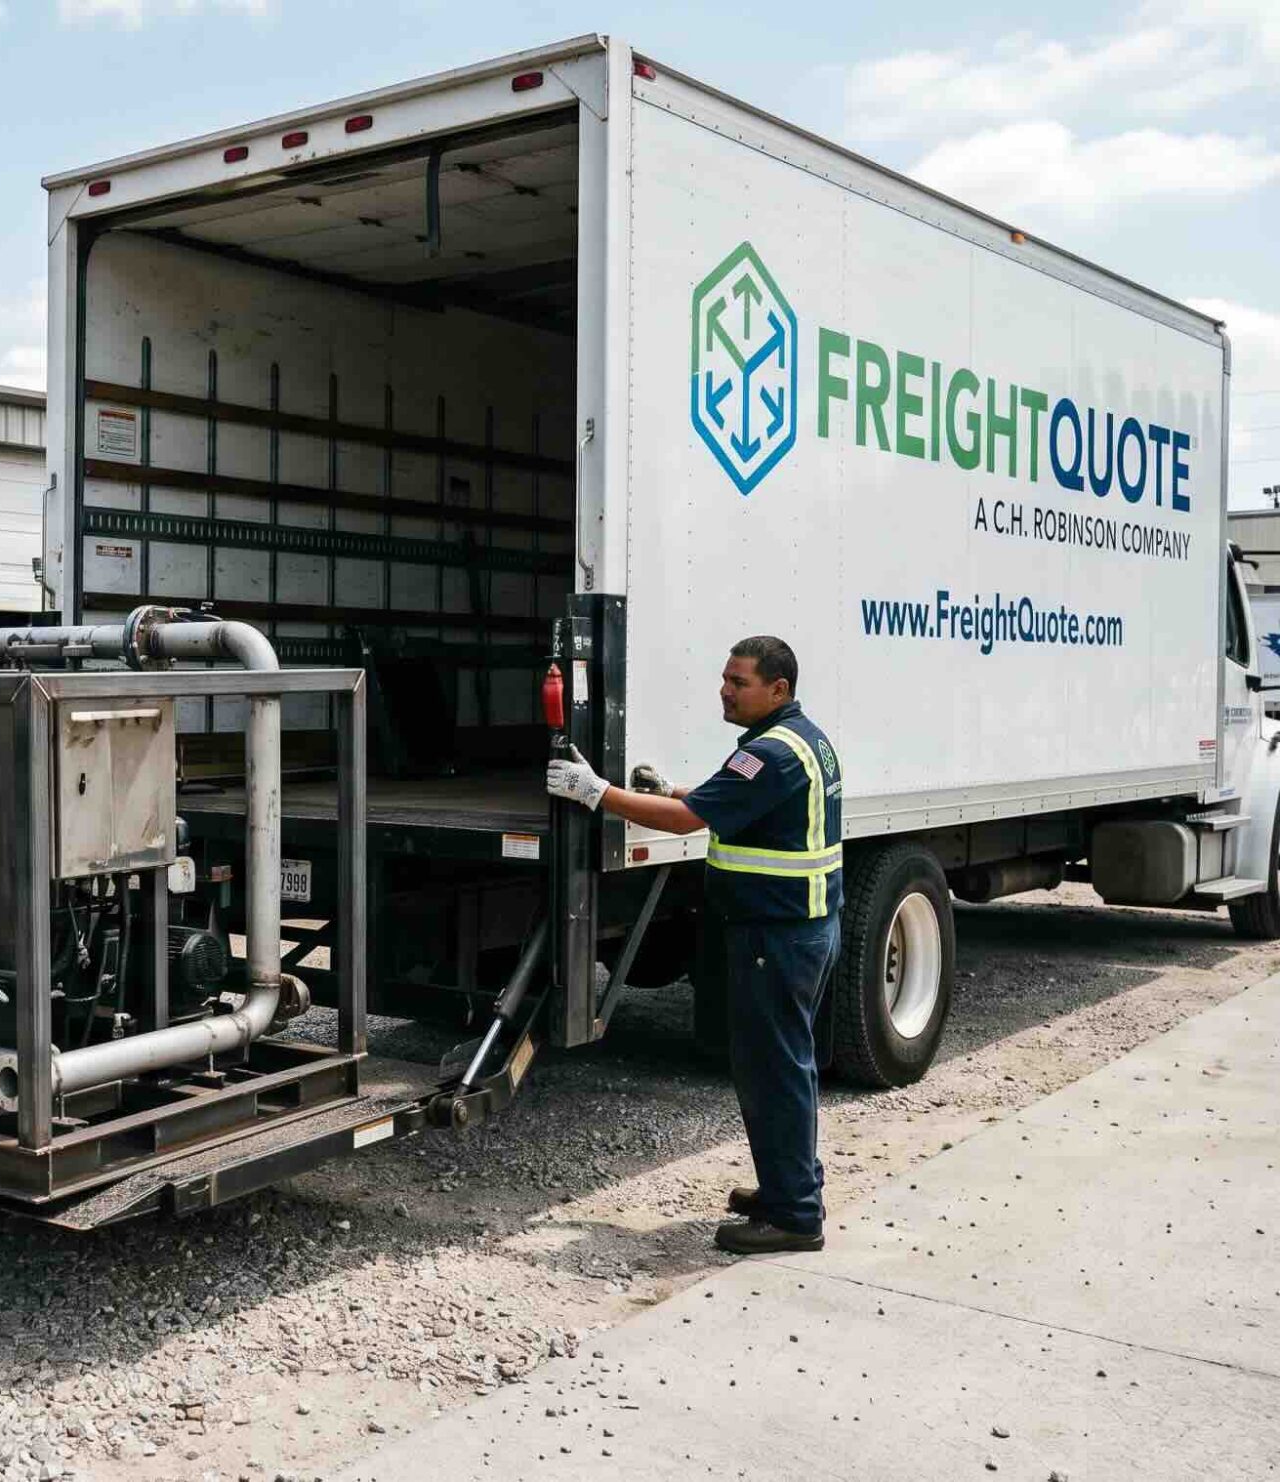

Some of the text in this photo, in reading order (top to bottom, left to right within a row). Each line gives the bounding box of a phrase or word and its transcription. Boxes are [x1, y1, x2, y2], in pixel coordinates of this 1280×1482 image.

[817, 327, 1191, 512] FREIGHTQUOTE
[974, 497, 1191, 560] A C.H. ROBINSON COMPANY
[861, 590, 1123, 655] www.FreightQuote.com
